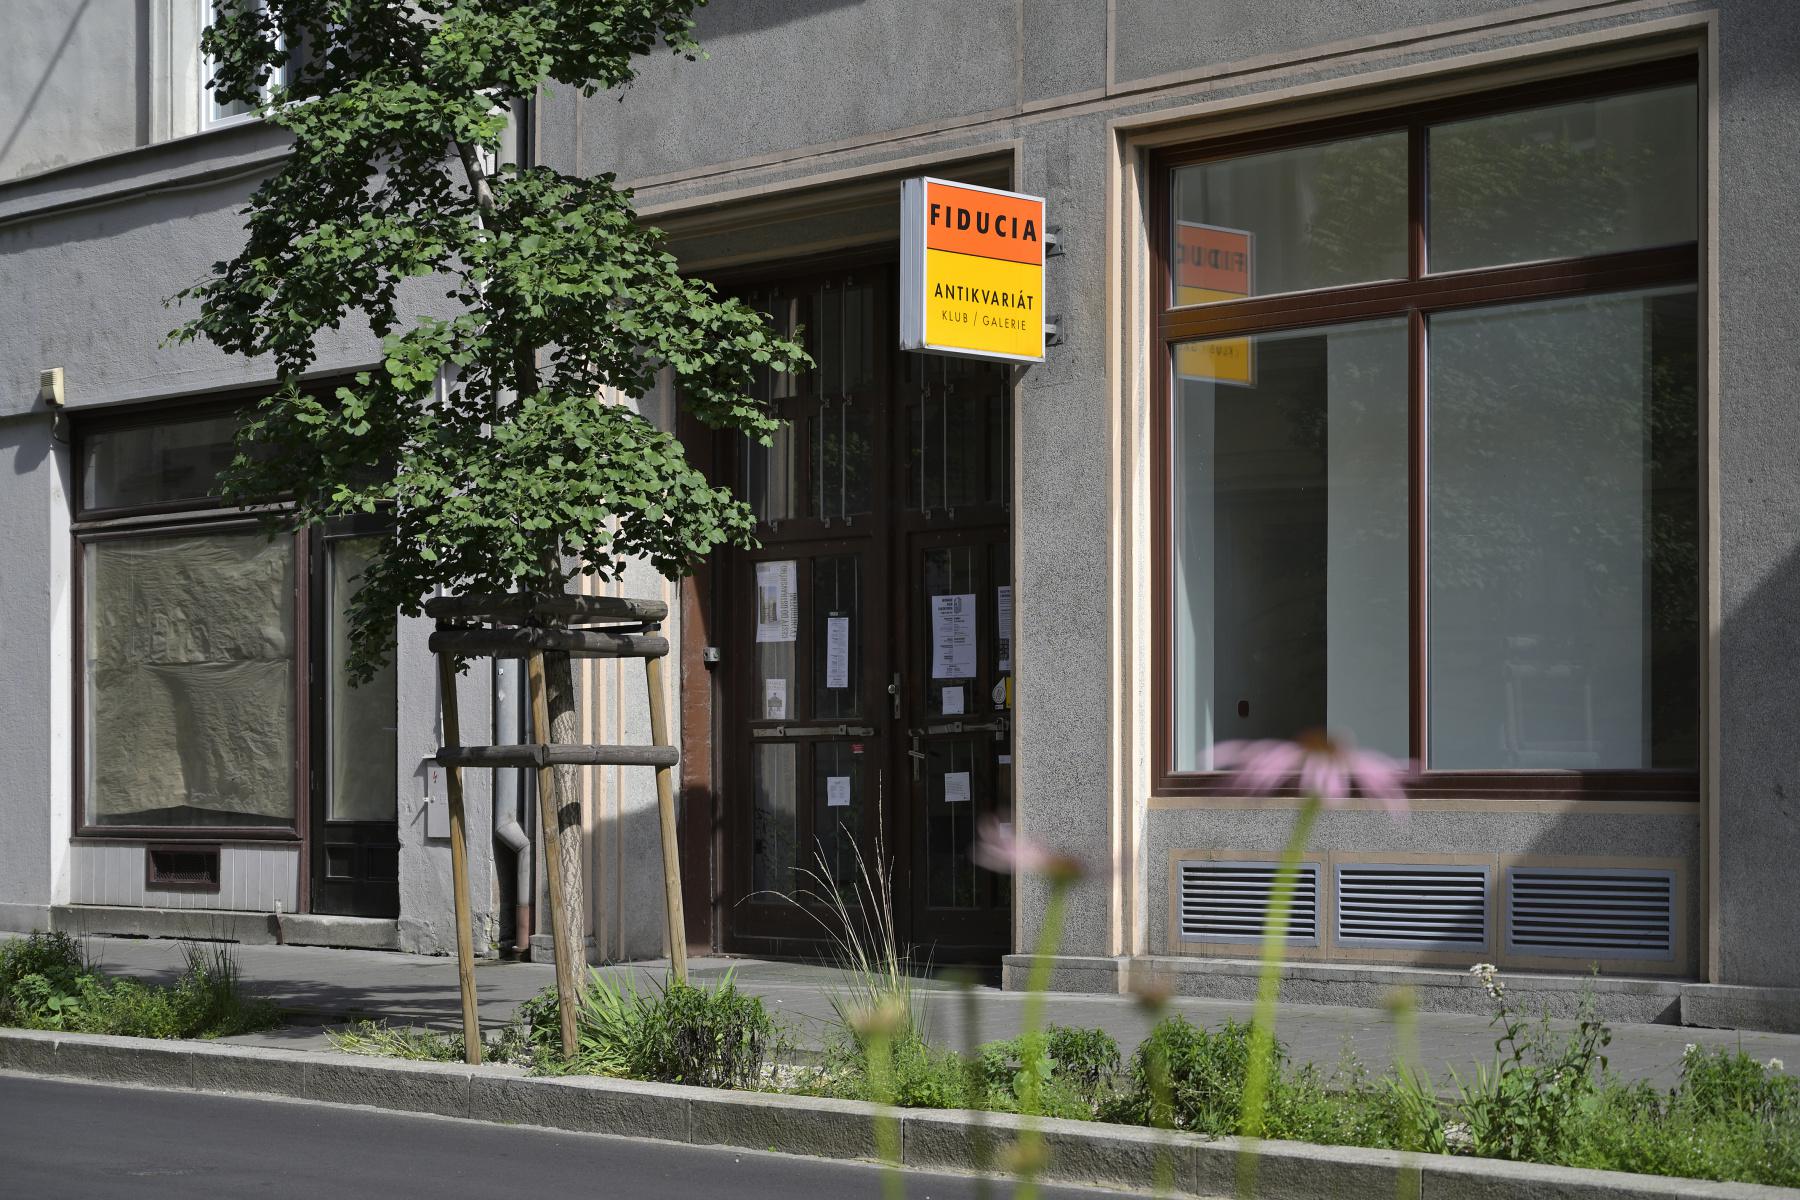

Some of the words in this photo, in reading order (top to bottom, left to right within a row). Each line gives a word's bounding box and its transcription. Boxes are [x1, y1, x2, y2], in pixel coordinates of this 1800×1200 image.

[930, 203, 1037, 242] FIDUCIA
[934, 282, 1034, 310] ANTIKVARIÁT
[942, 310, 968, 324] KLUB
[982, 315, 1027, 331] GALERIE
